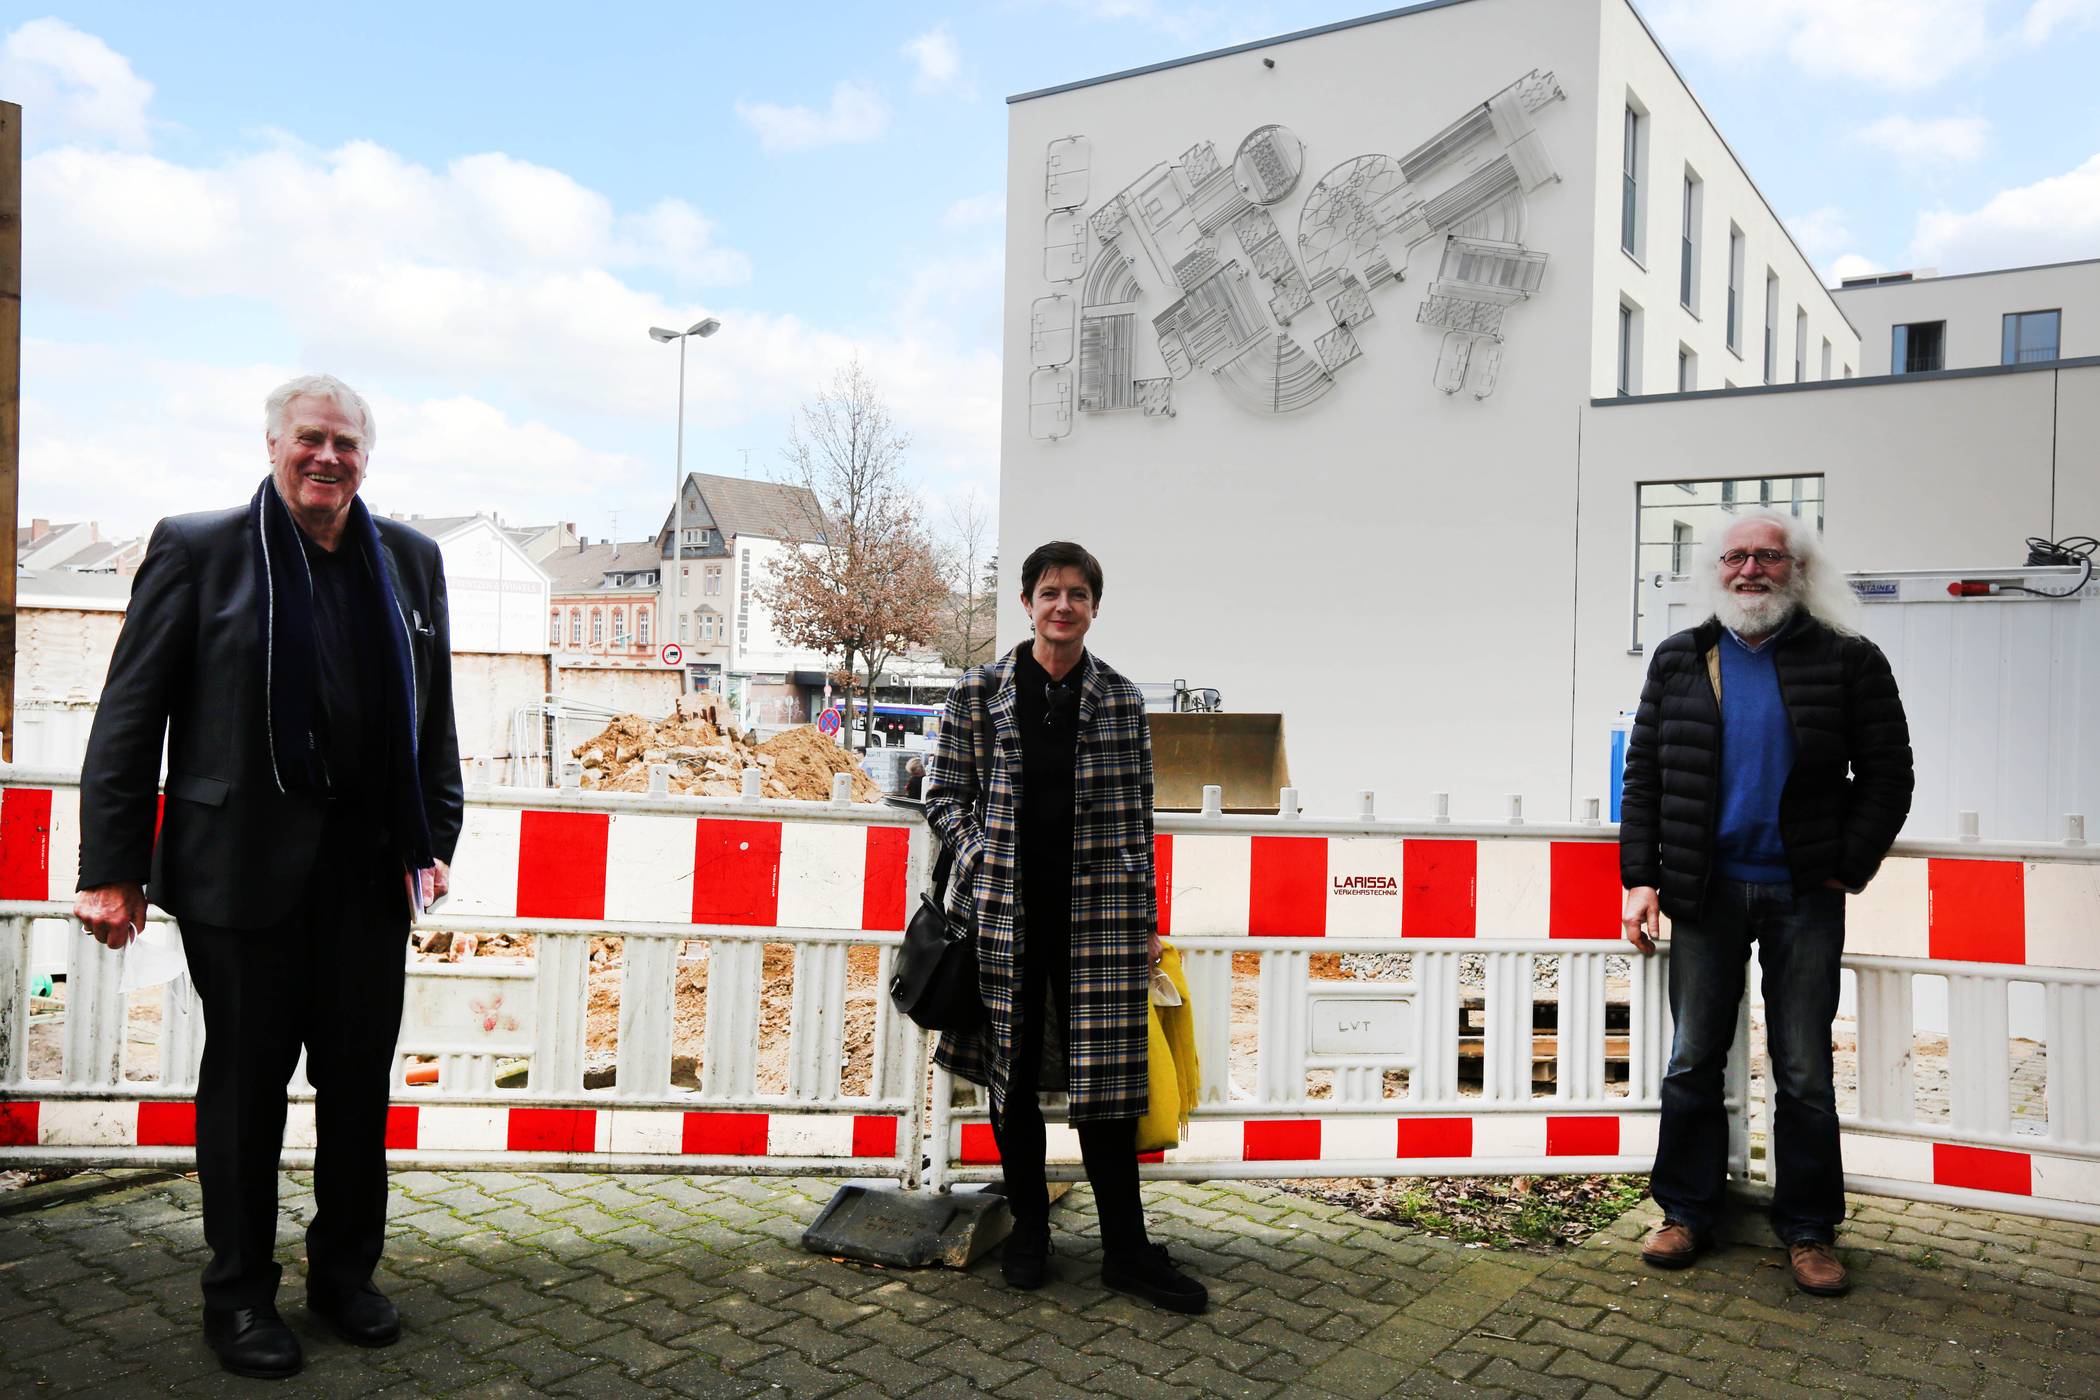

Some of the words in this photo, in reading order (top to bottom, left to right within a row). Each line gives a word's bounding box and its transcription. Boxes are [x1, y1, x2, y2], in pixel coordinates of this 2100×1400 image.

[737, 548, 750, 659] Tellmann
[1334, 876, 1397, 888] LARISSA
[1338, 1021, 1371, 1032] LVT
